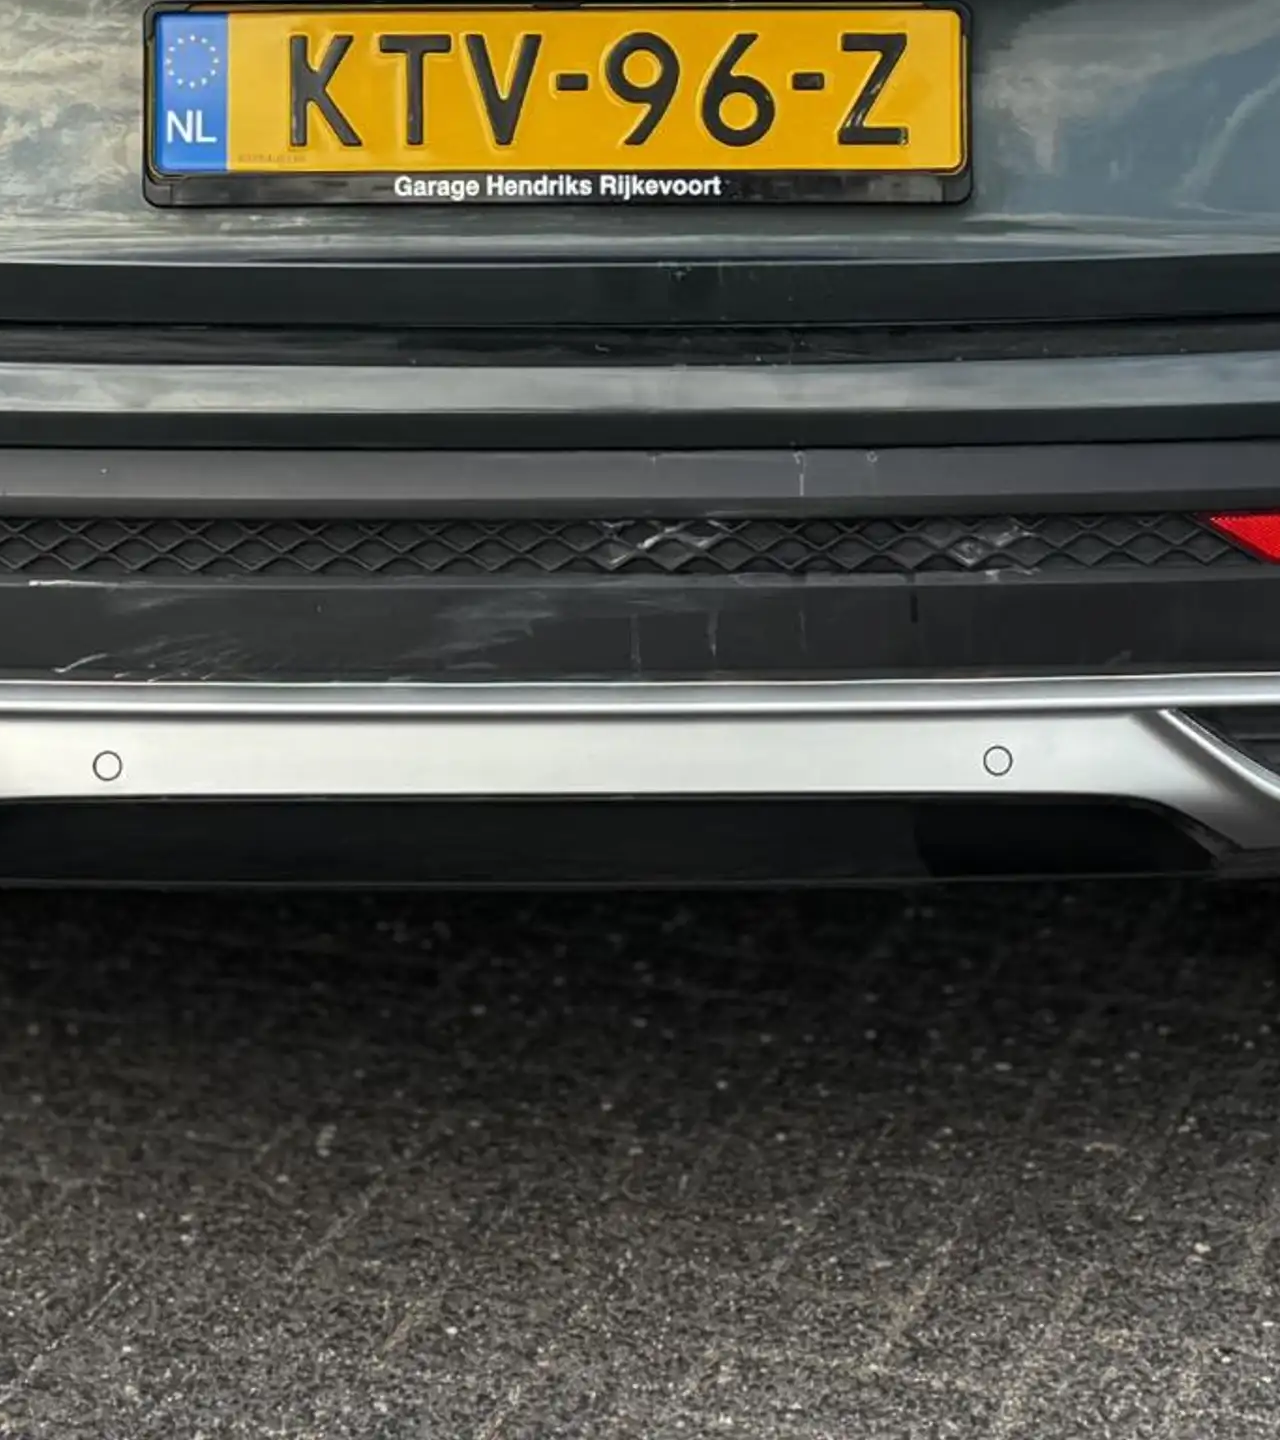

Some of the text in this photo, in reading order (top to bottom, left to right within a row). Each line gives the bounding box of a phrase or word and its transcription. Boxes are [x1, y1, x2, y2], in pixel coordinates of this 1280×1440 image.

[289, 32, 908, 148] KTV-96-Z
[166, 110, 217, 144] NL
[394, 174, 722, 201] Garage Hendriks Rijkevoort
